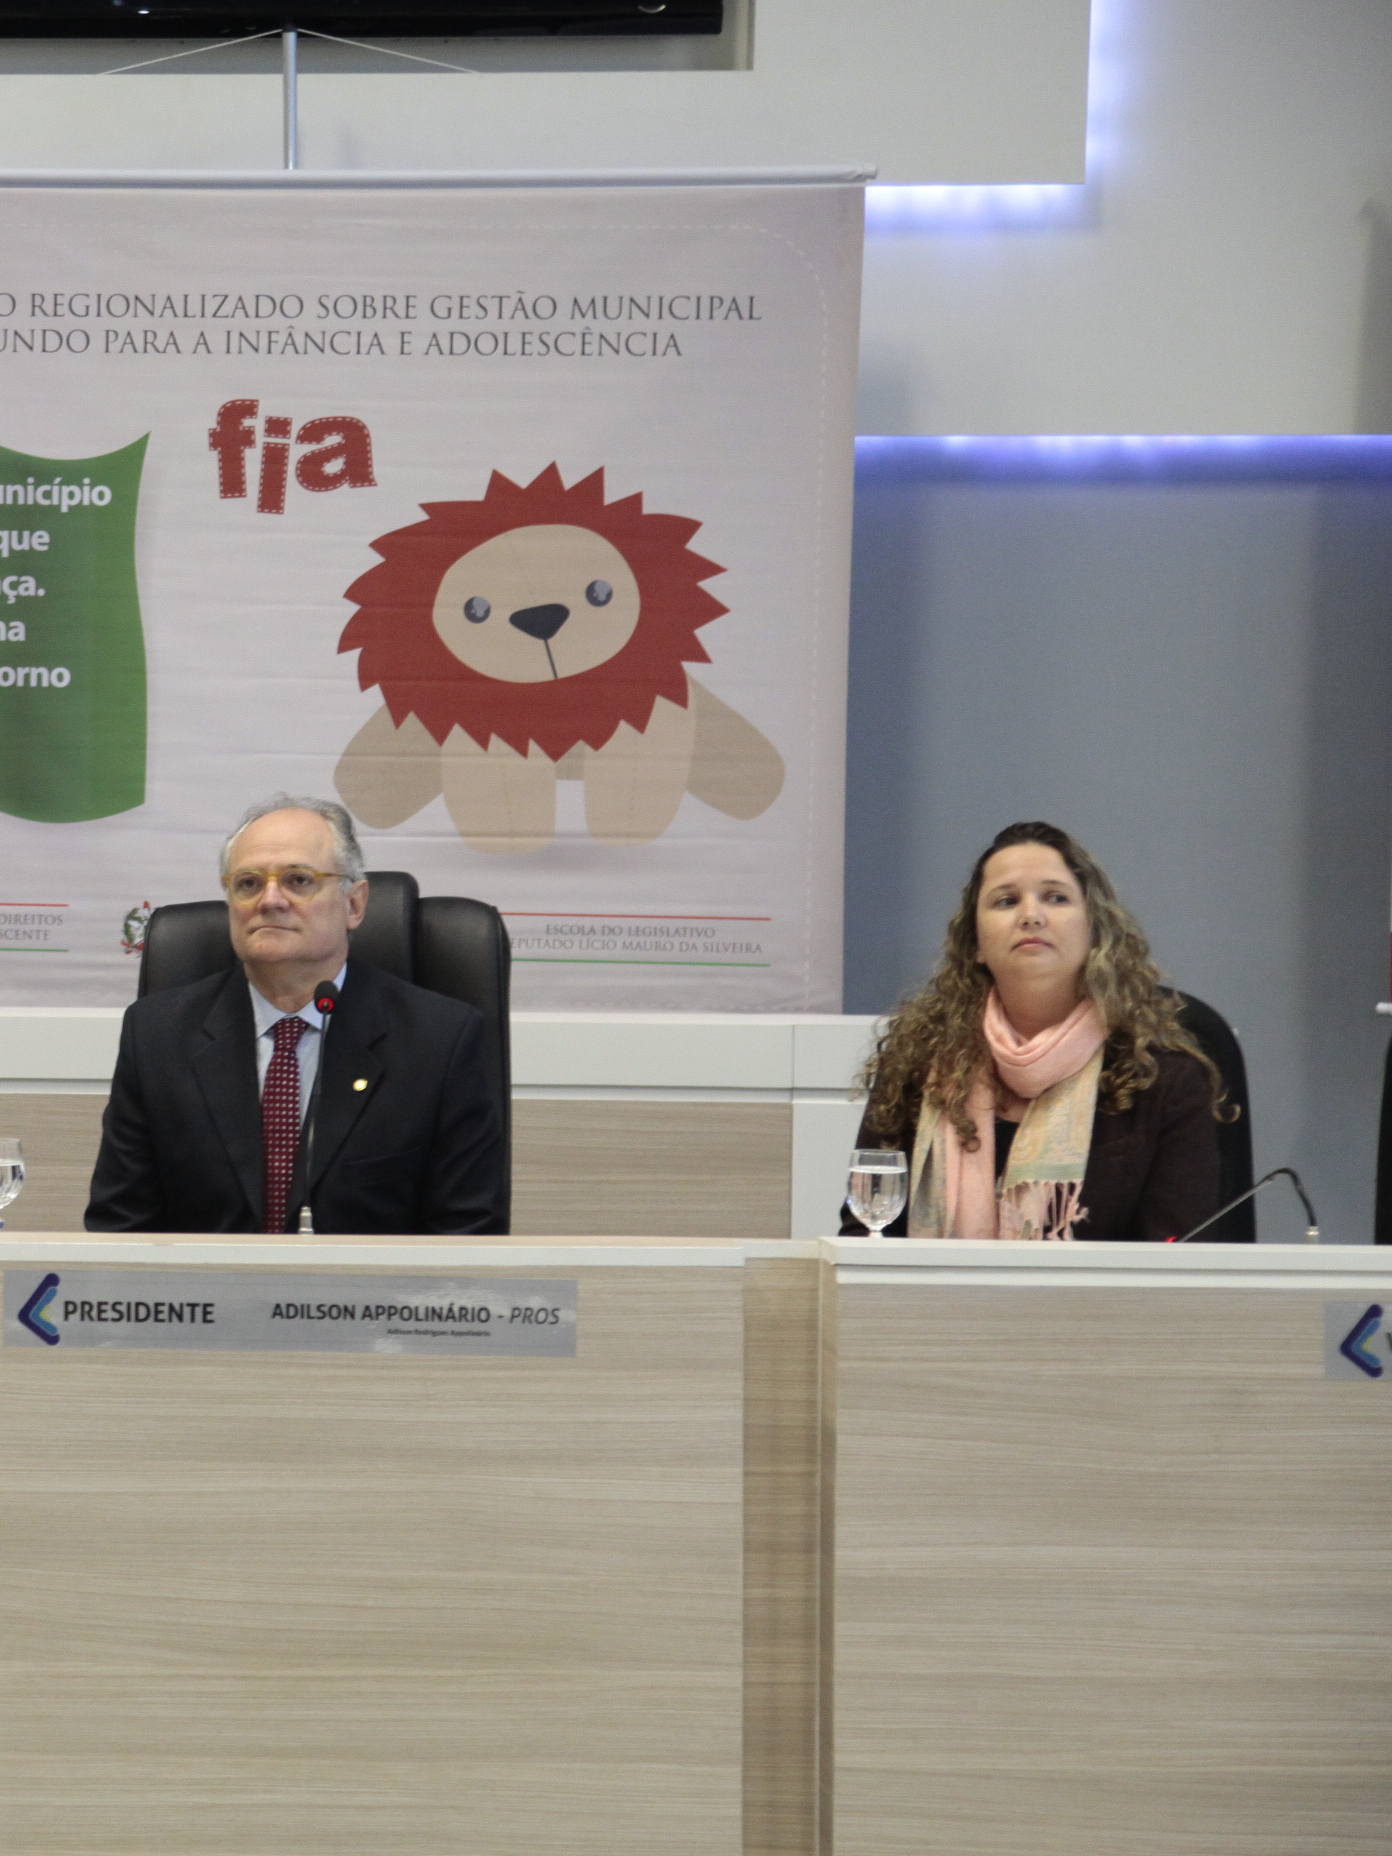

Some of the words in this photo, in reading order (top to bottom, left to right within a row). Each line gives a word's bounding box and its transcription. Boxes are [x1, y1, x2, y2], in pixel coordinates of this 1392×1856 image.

[29, 292, 305, 319] REGIONALIZADO
[317, 294, 418, 320] SOBRE
[430, 291, 558, 320] GESTÃO
[571, 295, 763, 321] MUNICIPAL
[104, 330, 182, 355] PARA
[192, 331, 213, 355] A
[225, 326, 386, 355] INFÂNCIA
[400, 331, 413, 355] E
[425, 328, 684, 357] ADOLESCÊNCIA
[209, 399, 377, 514] fia
[546, 924, 596, 935] ESCOLA
[600, 925, 623, 936] DO
[628, 926, 715, 938] LEGISLATIVO
[509, 938, 574, 950] EPUTADO
[579, 938, 617, 950] LÍCIO
[622, 940, 674, 952] MAURO
[679, 941, 698, 952] DA
[702, 942, 762, 953] SILVEIRA
[63, 1301, 215, 1324] PRESIDENTE
[271, 1303, 356, 1321] ADILSON
[361, 1301, 491, 1324] APPOLINÁRIO
[509, 1306, 561, 1326] PROS
